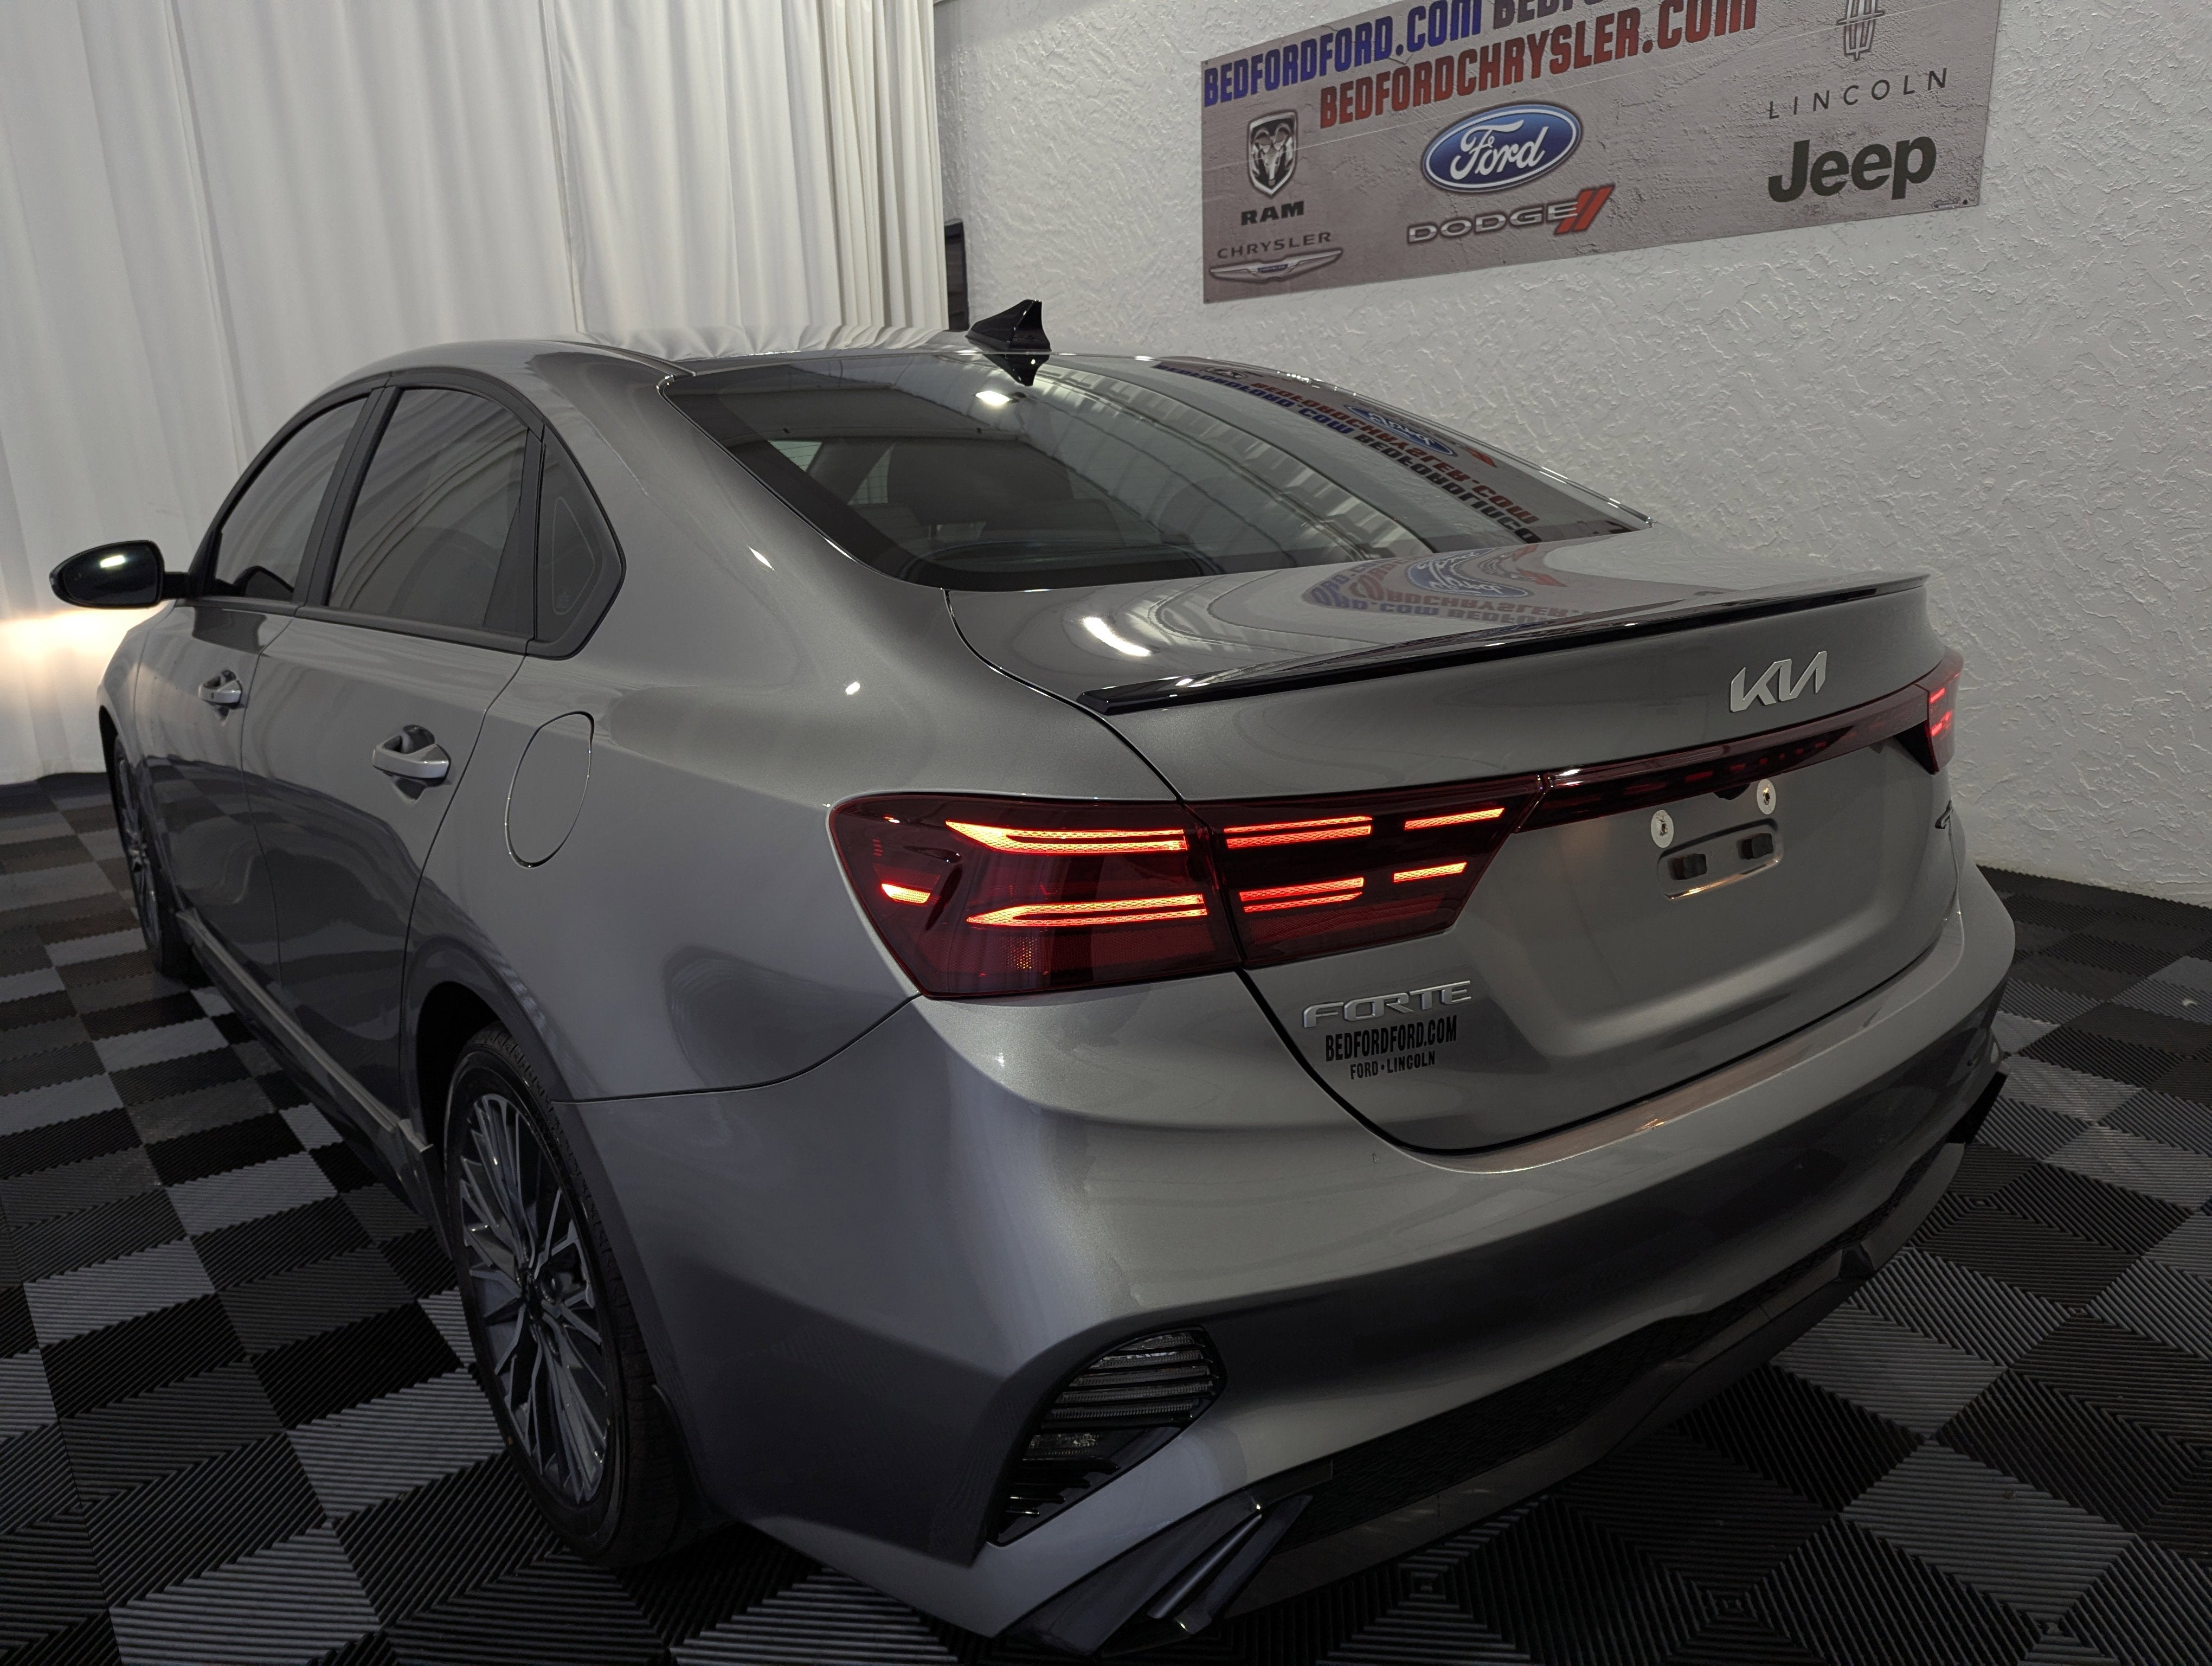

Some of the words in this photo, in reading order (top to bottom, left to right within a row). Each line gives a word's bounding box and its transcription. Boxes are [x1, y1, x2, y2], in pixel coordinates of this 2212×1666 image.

[1204, 0, 1482, 107] BEDFORDFORD.COM
[1321, 0, 1756, 129] BEDFORDCHRYSLER.COM
[1769, 68, 1947, 119] LINCOLN
[1450, 120, 1549, 180] Ford
[1768, 137, 1937, 203] Jeep
[1240, 201, 1304, 226] RAM
[1407, 201, 1579, 244] DODGE
[1217, 232, 1332, 259] CHRYSLER
[1729, 650, 1828, 712] KIA
[1303, 980, 1472, 1028] FORTE
[1326, 1015, 1457, 1062] BEDFORDFORD.COM
